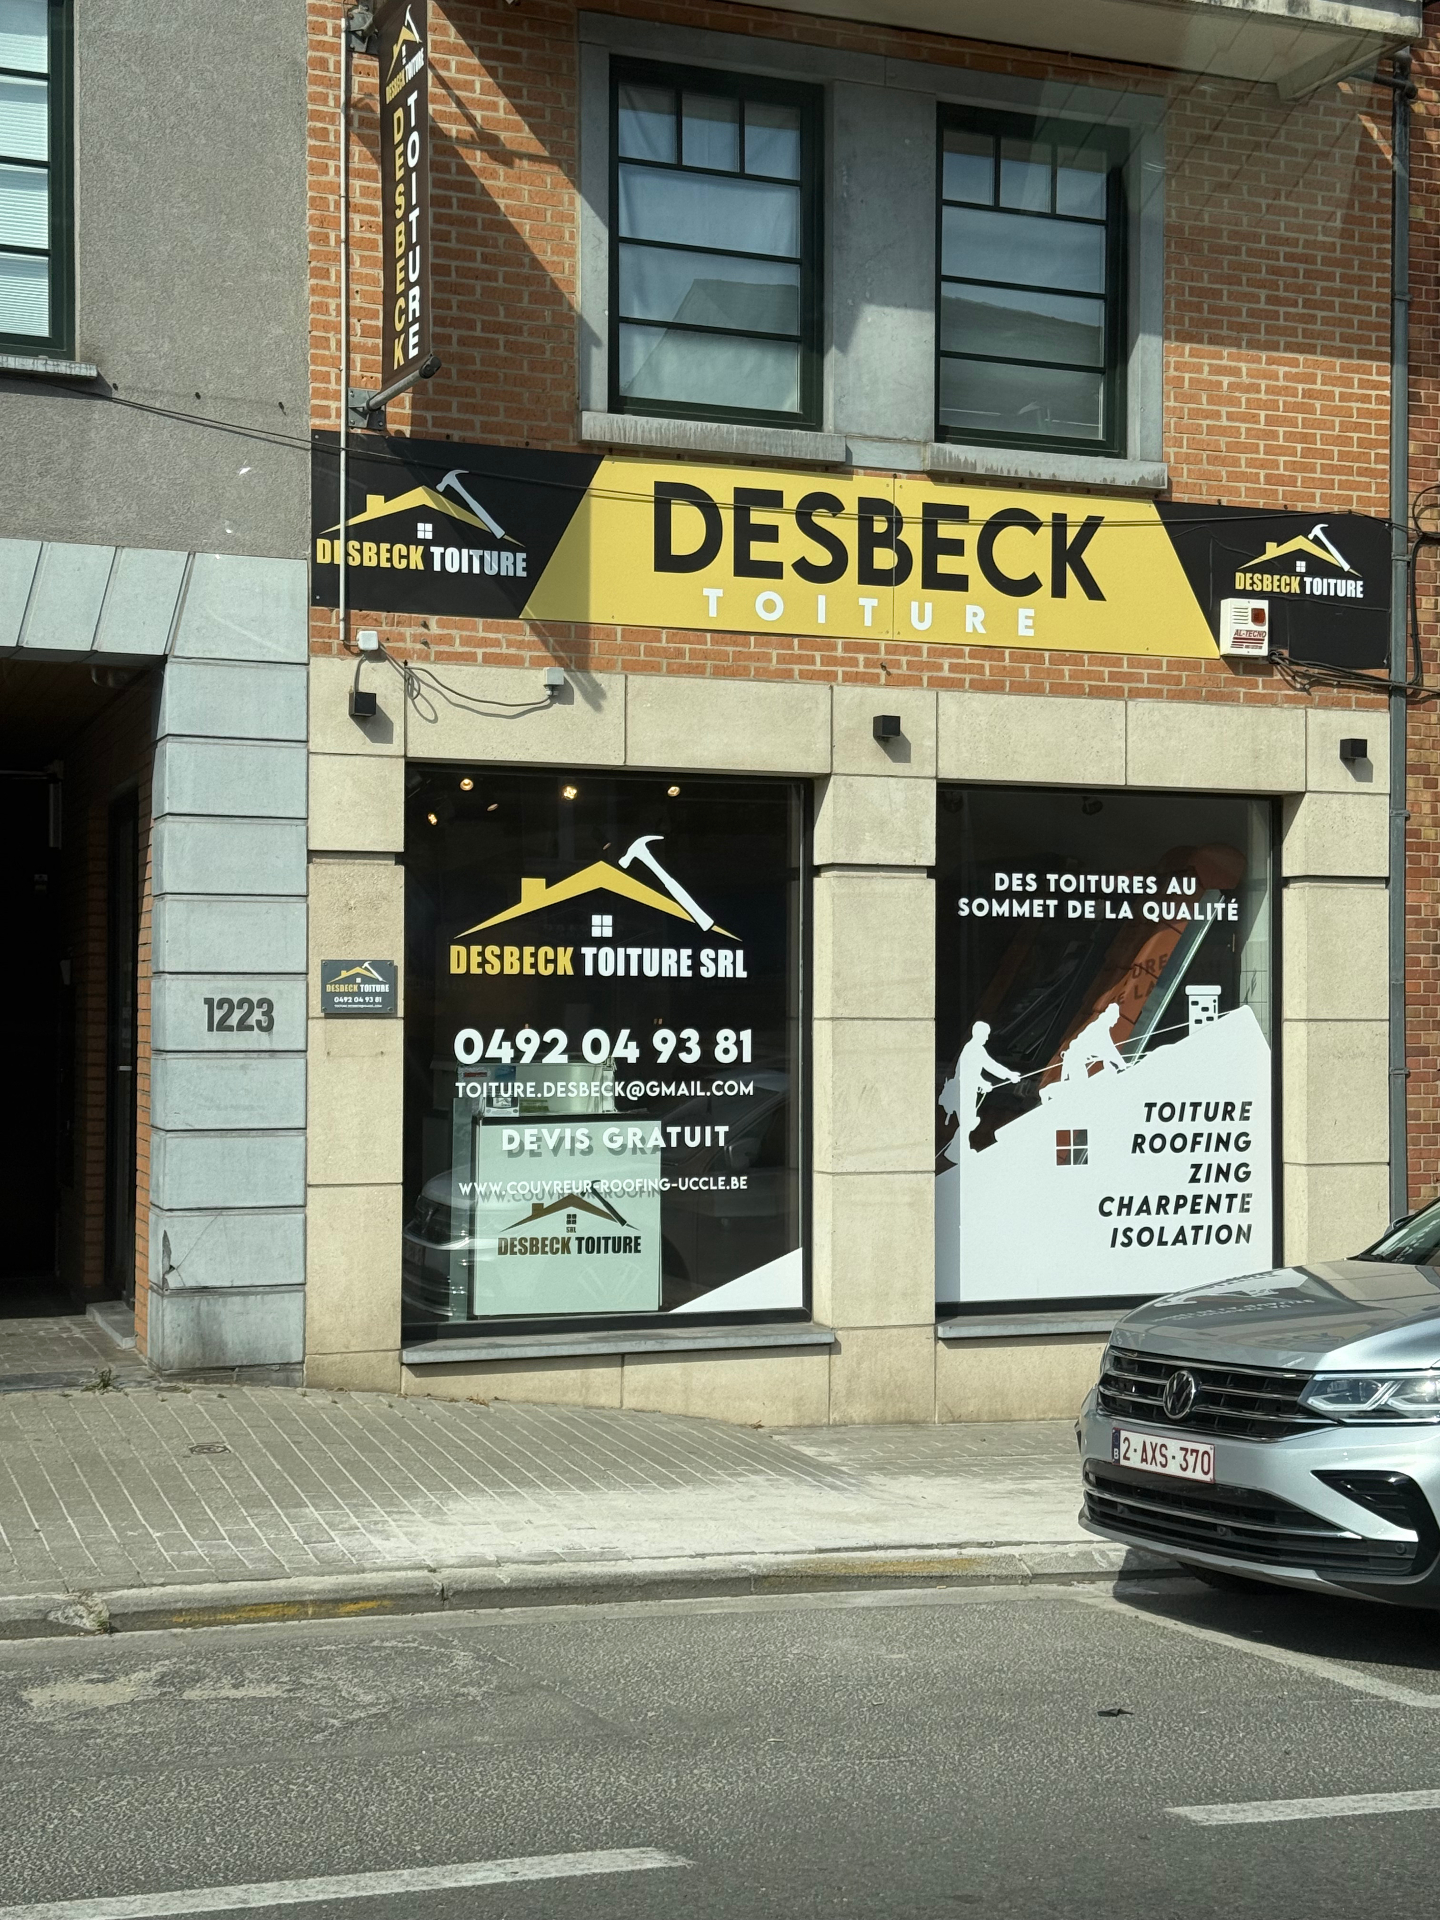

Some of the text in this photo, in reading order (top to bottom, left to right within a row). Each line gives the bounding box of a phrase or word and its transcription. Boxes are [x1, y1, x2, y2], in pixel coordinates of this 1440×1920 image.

[406, 90, 420, 360] TOITURE
[393, 106, 405, 370] DESBECK
[653, 480, 1107, 602] DESBECK
[430, 546, 527, 577] TOITURE
[1235, 572, 1364, 599] DESBECK TOITURE
[703, 587, 1036, 638] TOITURE
[1234, 629, 1267, 638] AL-TECNO
[994, 872, 1196, 896] DES TOITURES AU
[958, 897, 1239, 923] SOMMET DE LA QUALITÉ
[449, 944, 748, 979] DESBECK TOITURE SRL
[326, 984, 389, 993] DESBECK TOITURE
[203, 997, 275, 1033] 1223
[454, 1028, 752, 1064] 0492 04 93 81
[455, 1080, 754, 1100] TOITURE.DESBECK@GMAIL.COM
[1143, 1101, 1253, 1123] TOITURE
[502, 1125, 730, 1151] DEVIS GRATUIT
[1131, 1131, 1252, 1154] ROOFING
[1188, 1162, 1252, 1184] ZING
[458, 1176, 748, 1196] WWW.COUVREUR-ROOFING-UCCLE.BE
[1098, 1193, 1253, 1218] CHARPENTE
[497, 1235, 642, 1256] DESBECK TOITURE
[1110, 1224, 1253, 1248] ISOLATION
[1113, 1447, 1119, 1460] B
[1122, 1436, 1211, 1476] 2-AXS-370
